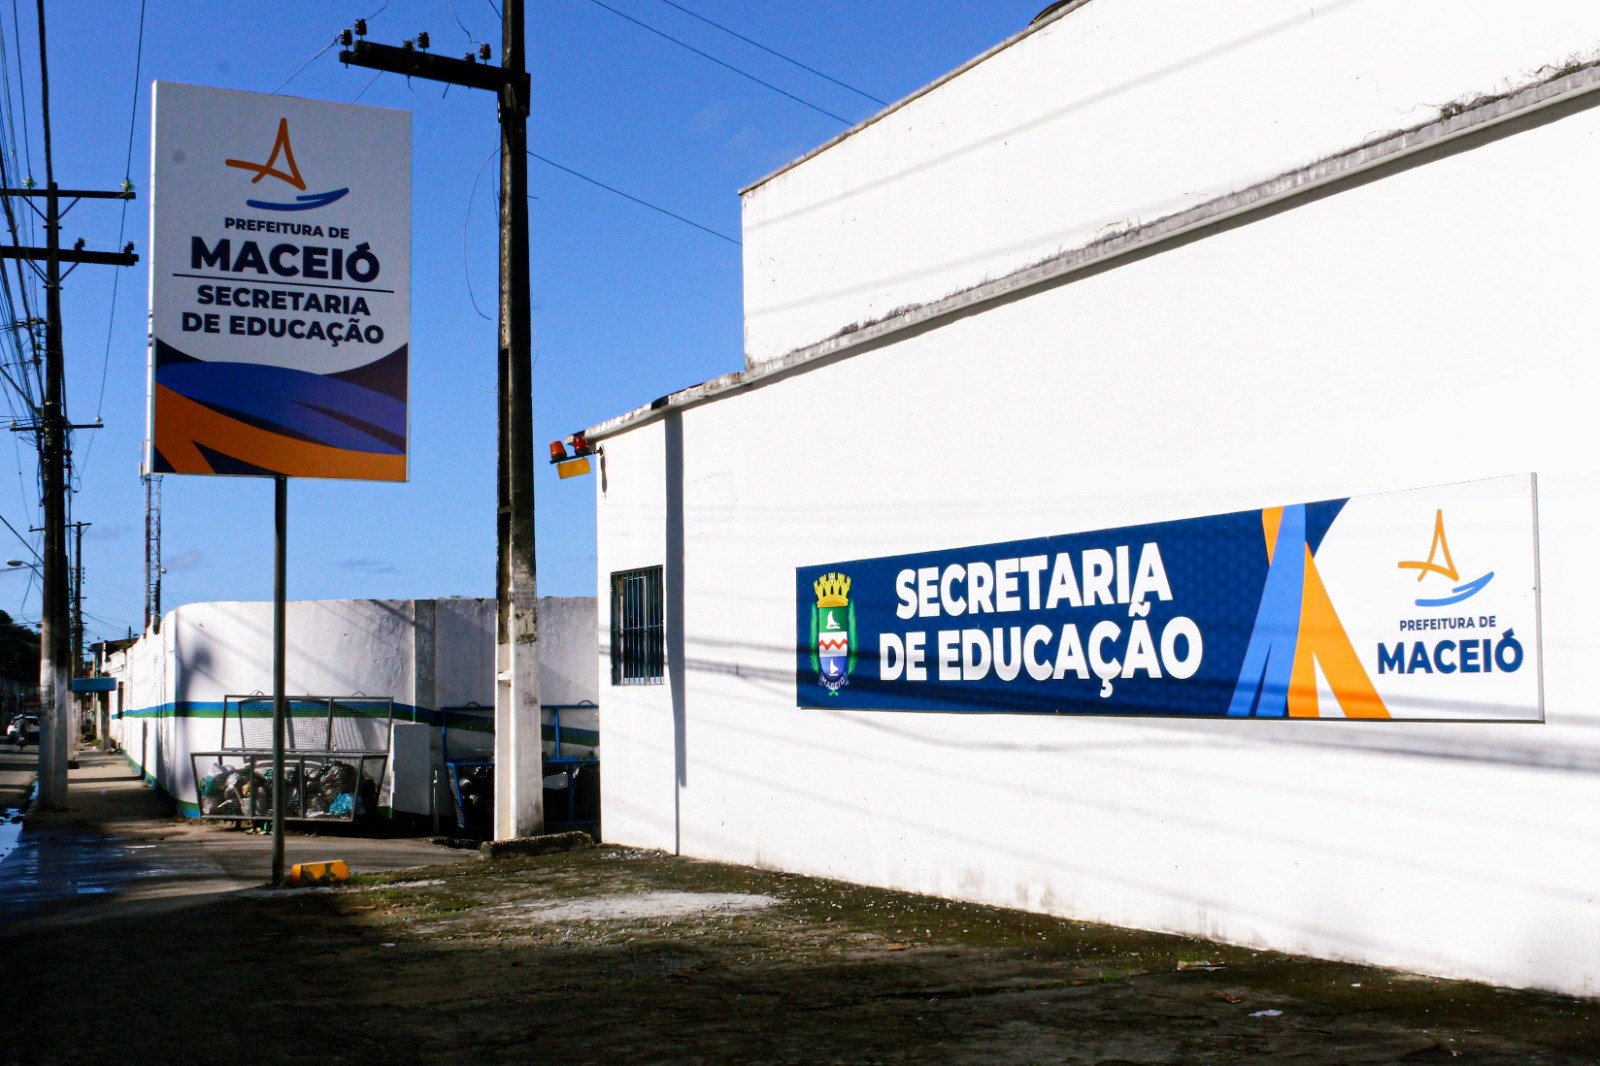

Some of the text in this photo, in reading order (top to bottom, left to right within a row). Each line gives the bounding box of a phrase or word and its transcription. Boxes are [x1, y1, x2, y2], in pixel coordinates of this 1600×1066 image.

[224, 217, 349, 240] PREFEITURA DE
[191, 236, 380, 283] MACEIÓ
[197, 285, 370, 316] SECRETARIA
[182, 312, 384, 347] DE EDUCAÇÃO
[896, 542, 1173, 619] SECRETARIA
[1400, 616, 1496, 631] PREFEITURA DE
[879, 602, 1203, 698] DE EDUCAÇÃO
[1377, 628, 1524, 674] MACEIÓ
